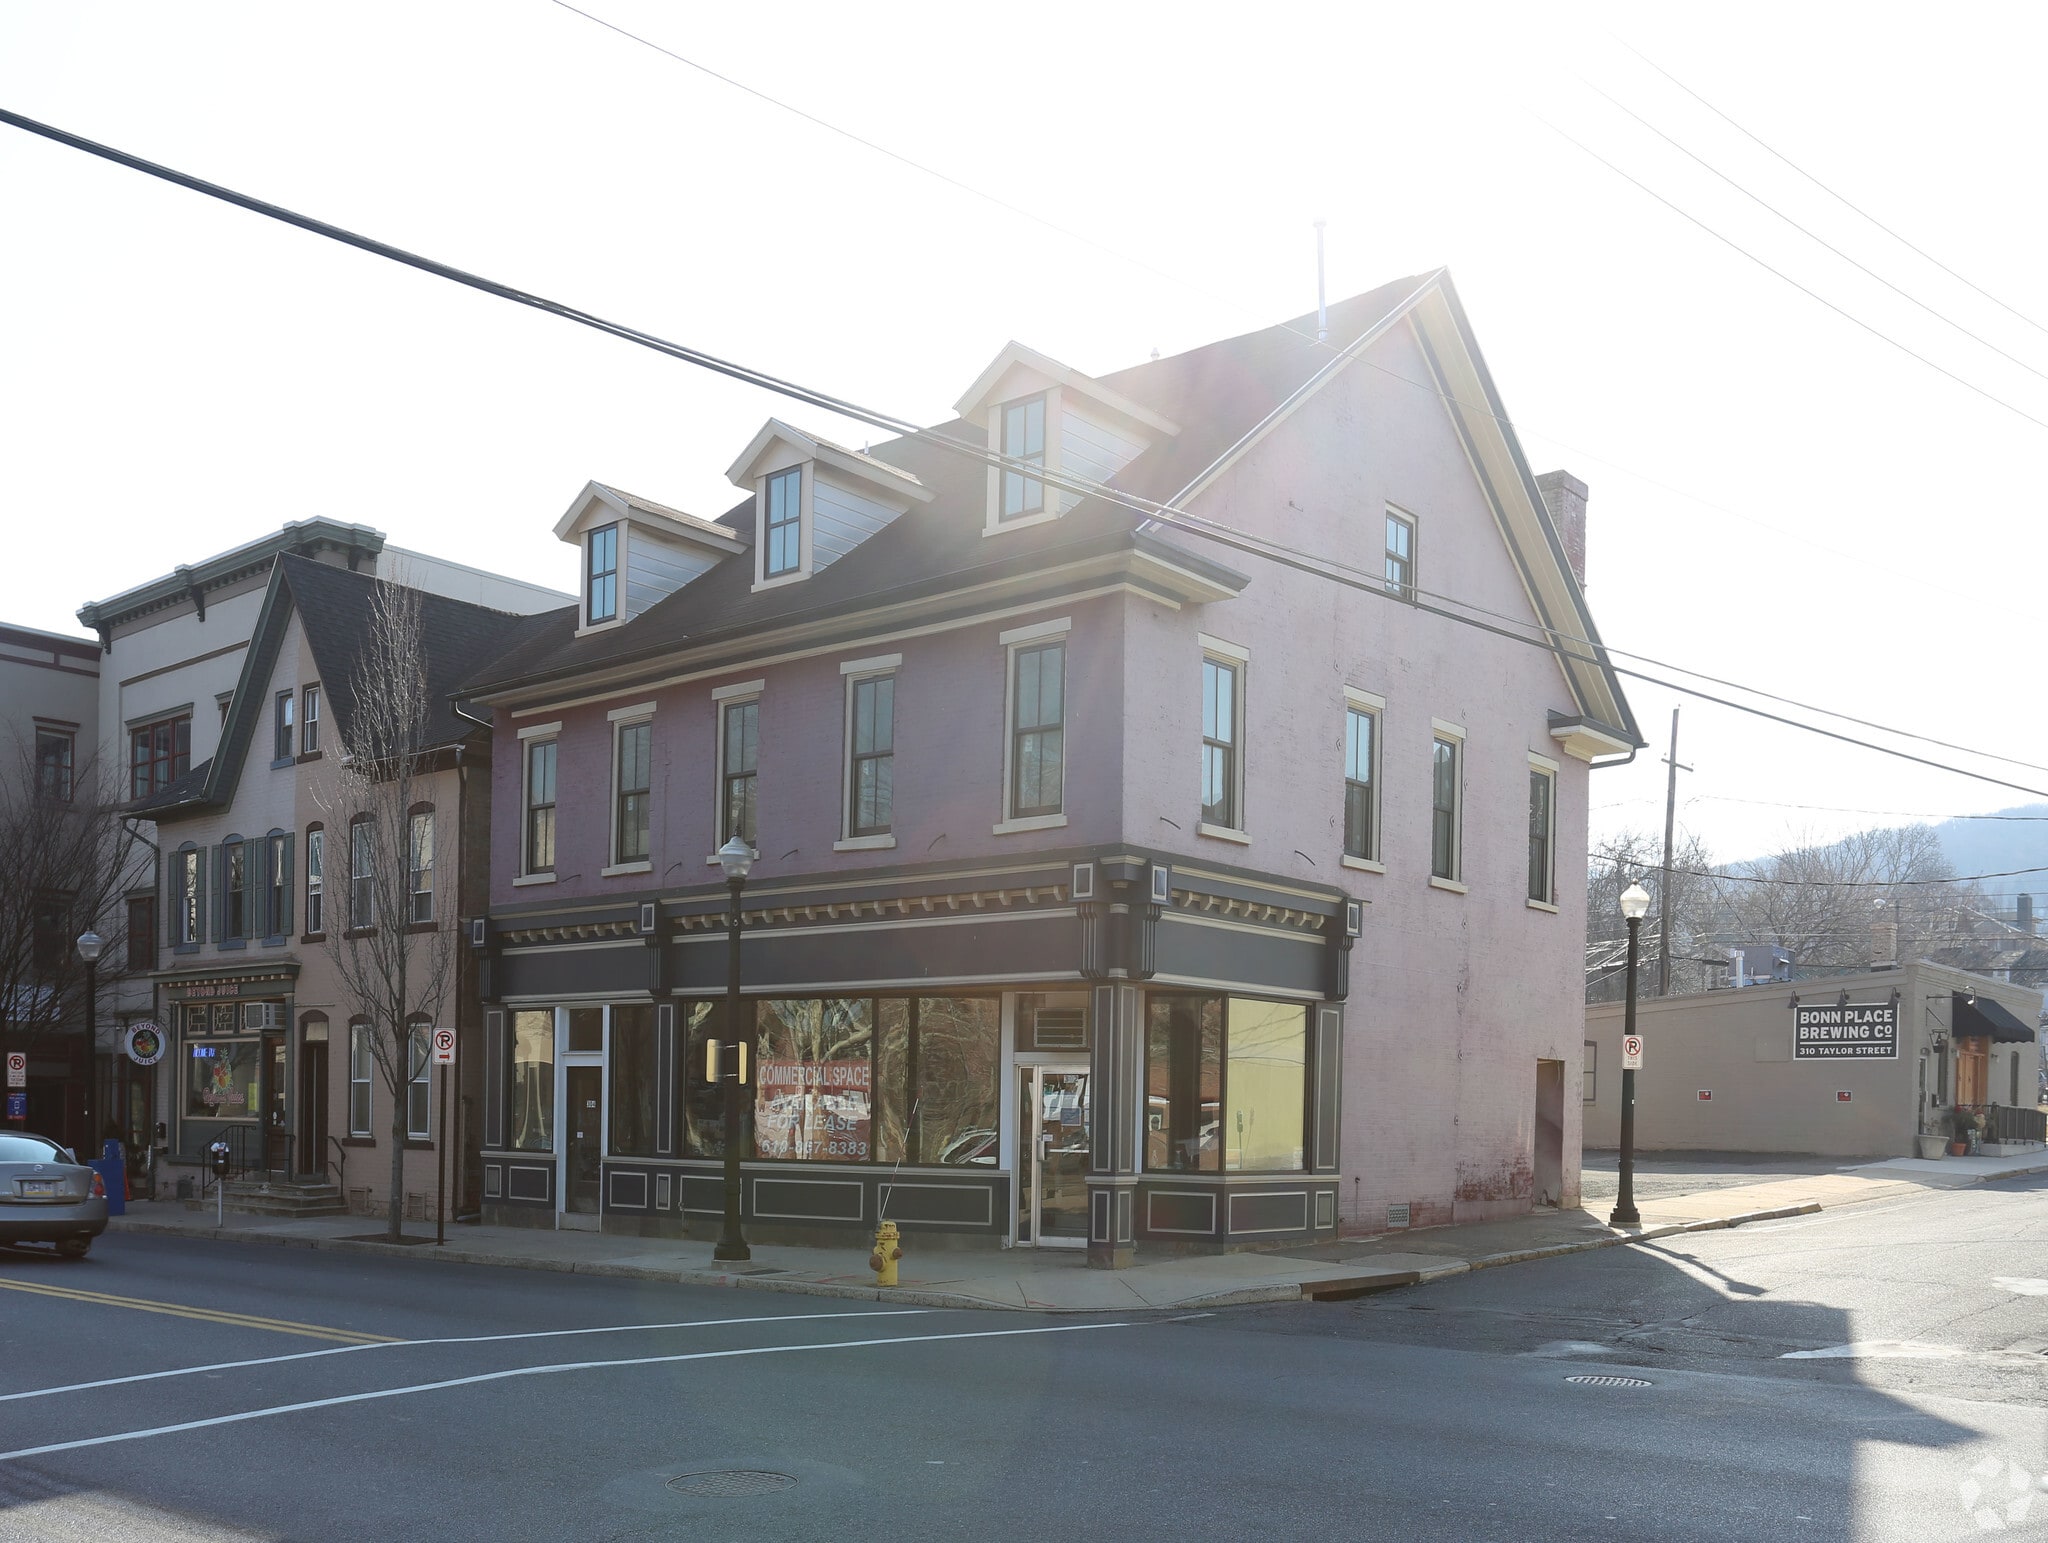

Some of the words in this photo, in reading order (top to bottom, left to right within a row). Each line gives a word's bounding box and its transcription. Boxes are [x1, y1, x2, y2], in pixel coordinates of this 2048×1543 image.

[1800, 1010, 1841, 1024] BONN
[1844, 1009, 1893, 1023] PLACE
[131, 1023, 160, 1034] BEYOND
[1800, 1025, 1870, 1039] BREWING
[1800, 1047, 1815, 1055] 310
[1818, 1047, 1853, 1055] TAYLOR
[1856, 1047, 1892, 1055] STREET
[133, 1056, 158, 1064] JUICE
[760, 1065, 830, 1086] COMMERCIAL
[833, 1065, 869, 1086] SPACE
[767, 1115, 800, 1129] FOR
[804, 1115, 859, 1131] LEASE
